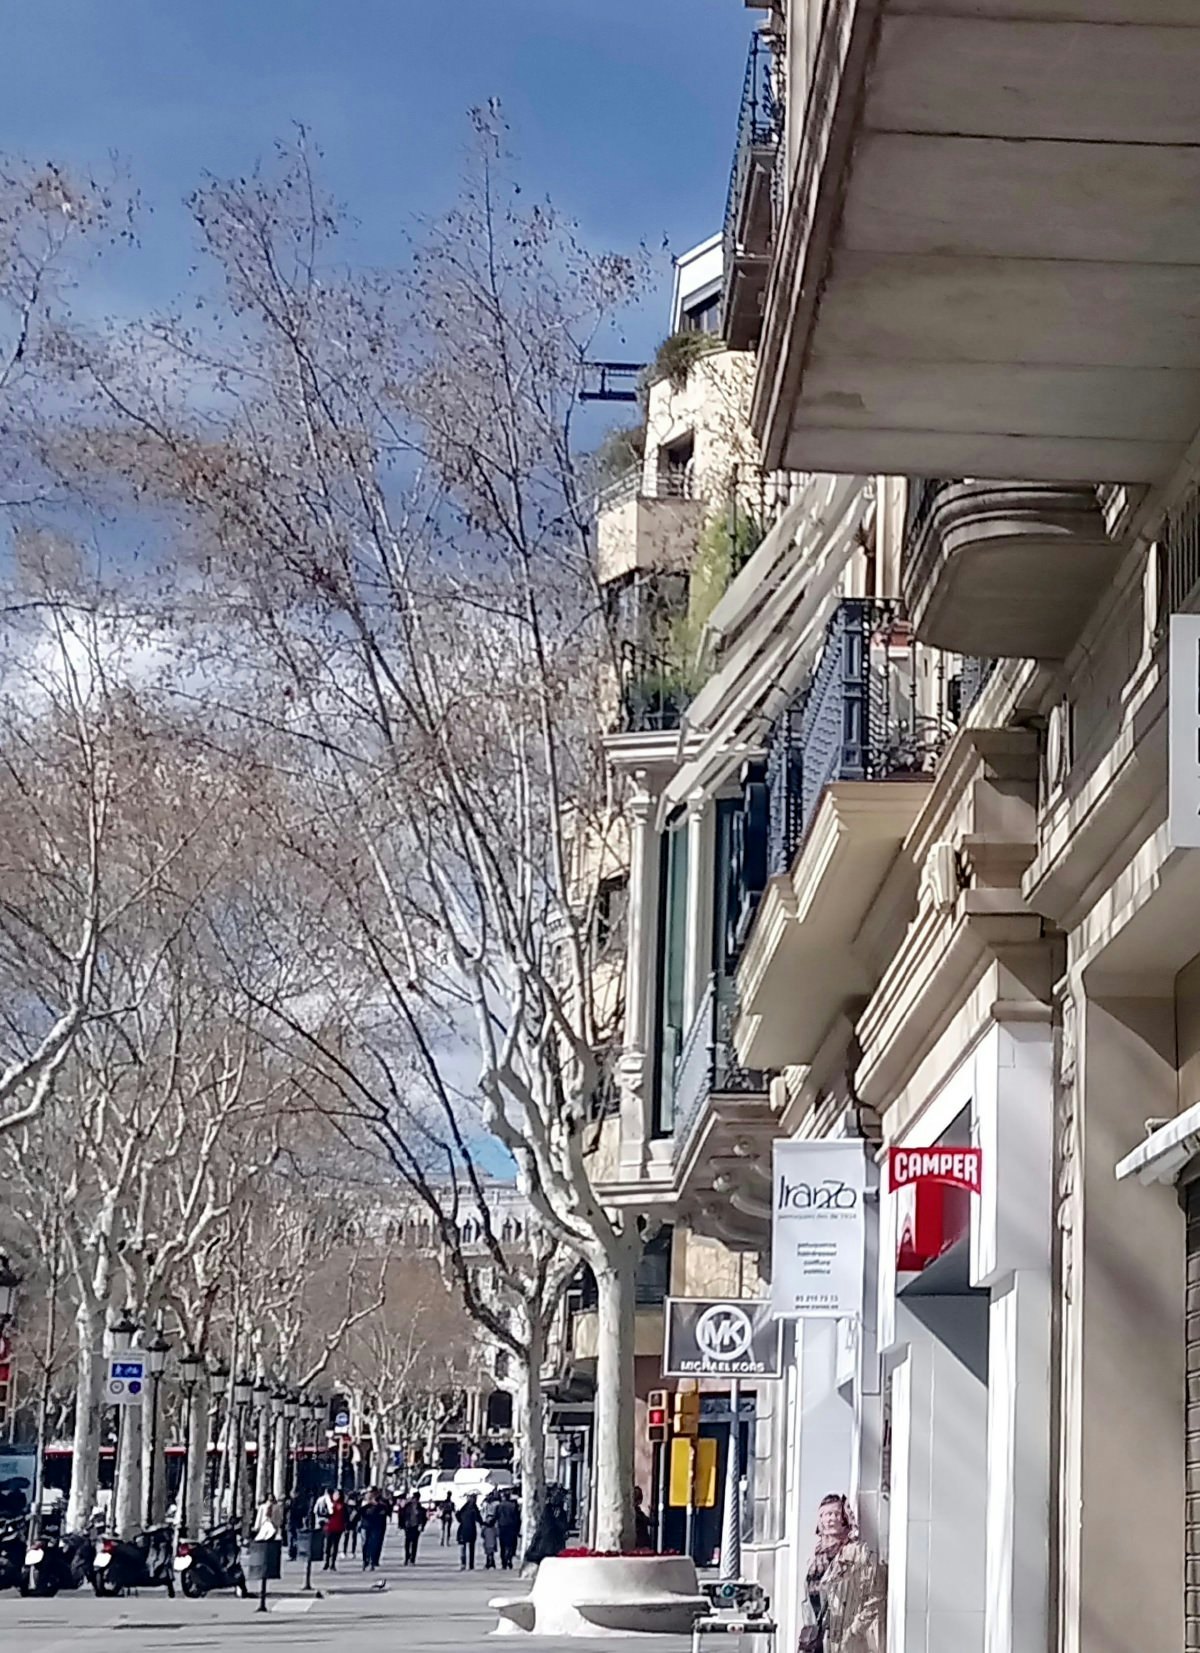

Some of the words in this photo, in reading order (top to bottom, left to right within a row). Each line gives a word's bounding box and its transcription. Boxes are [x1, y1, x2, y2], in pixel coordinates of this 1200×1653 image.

[894, 1152, 979, 1186] CAMPER
[681, 1360, 731, 1372] MICHAEL
[732, 1361, 765, 1372] KORS
